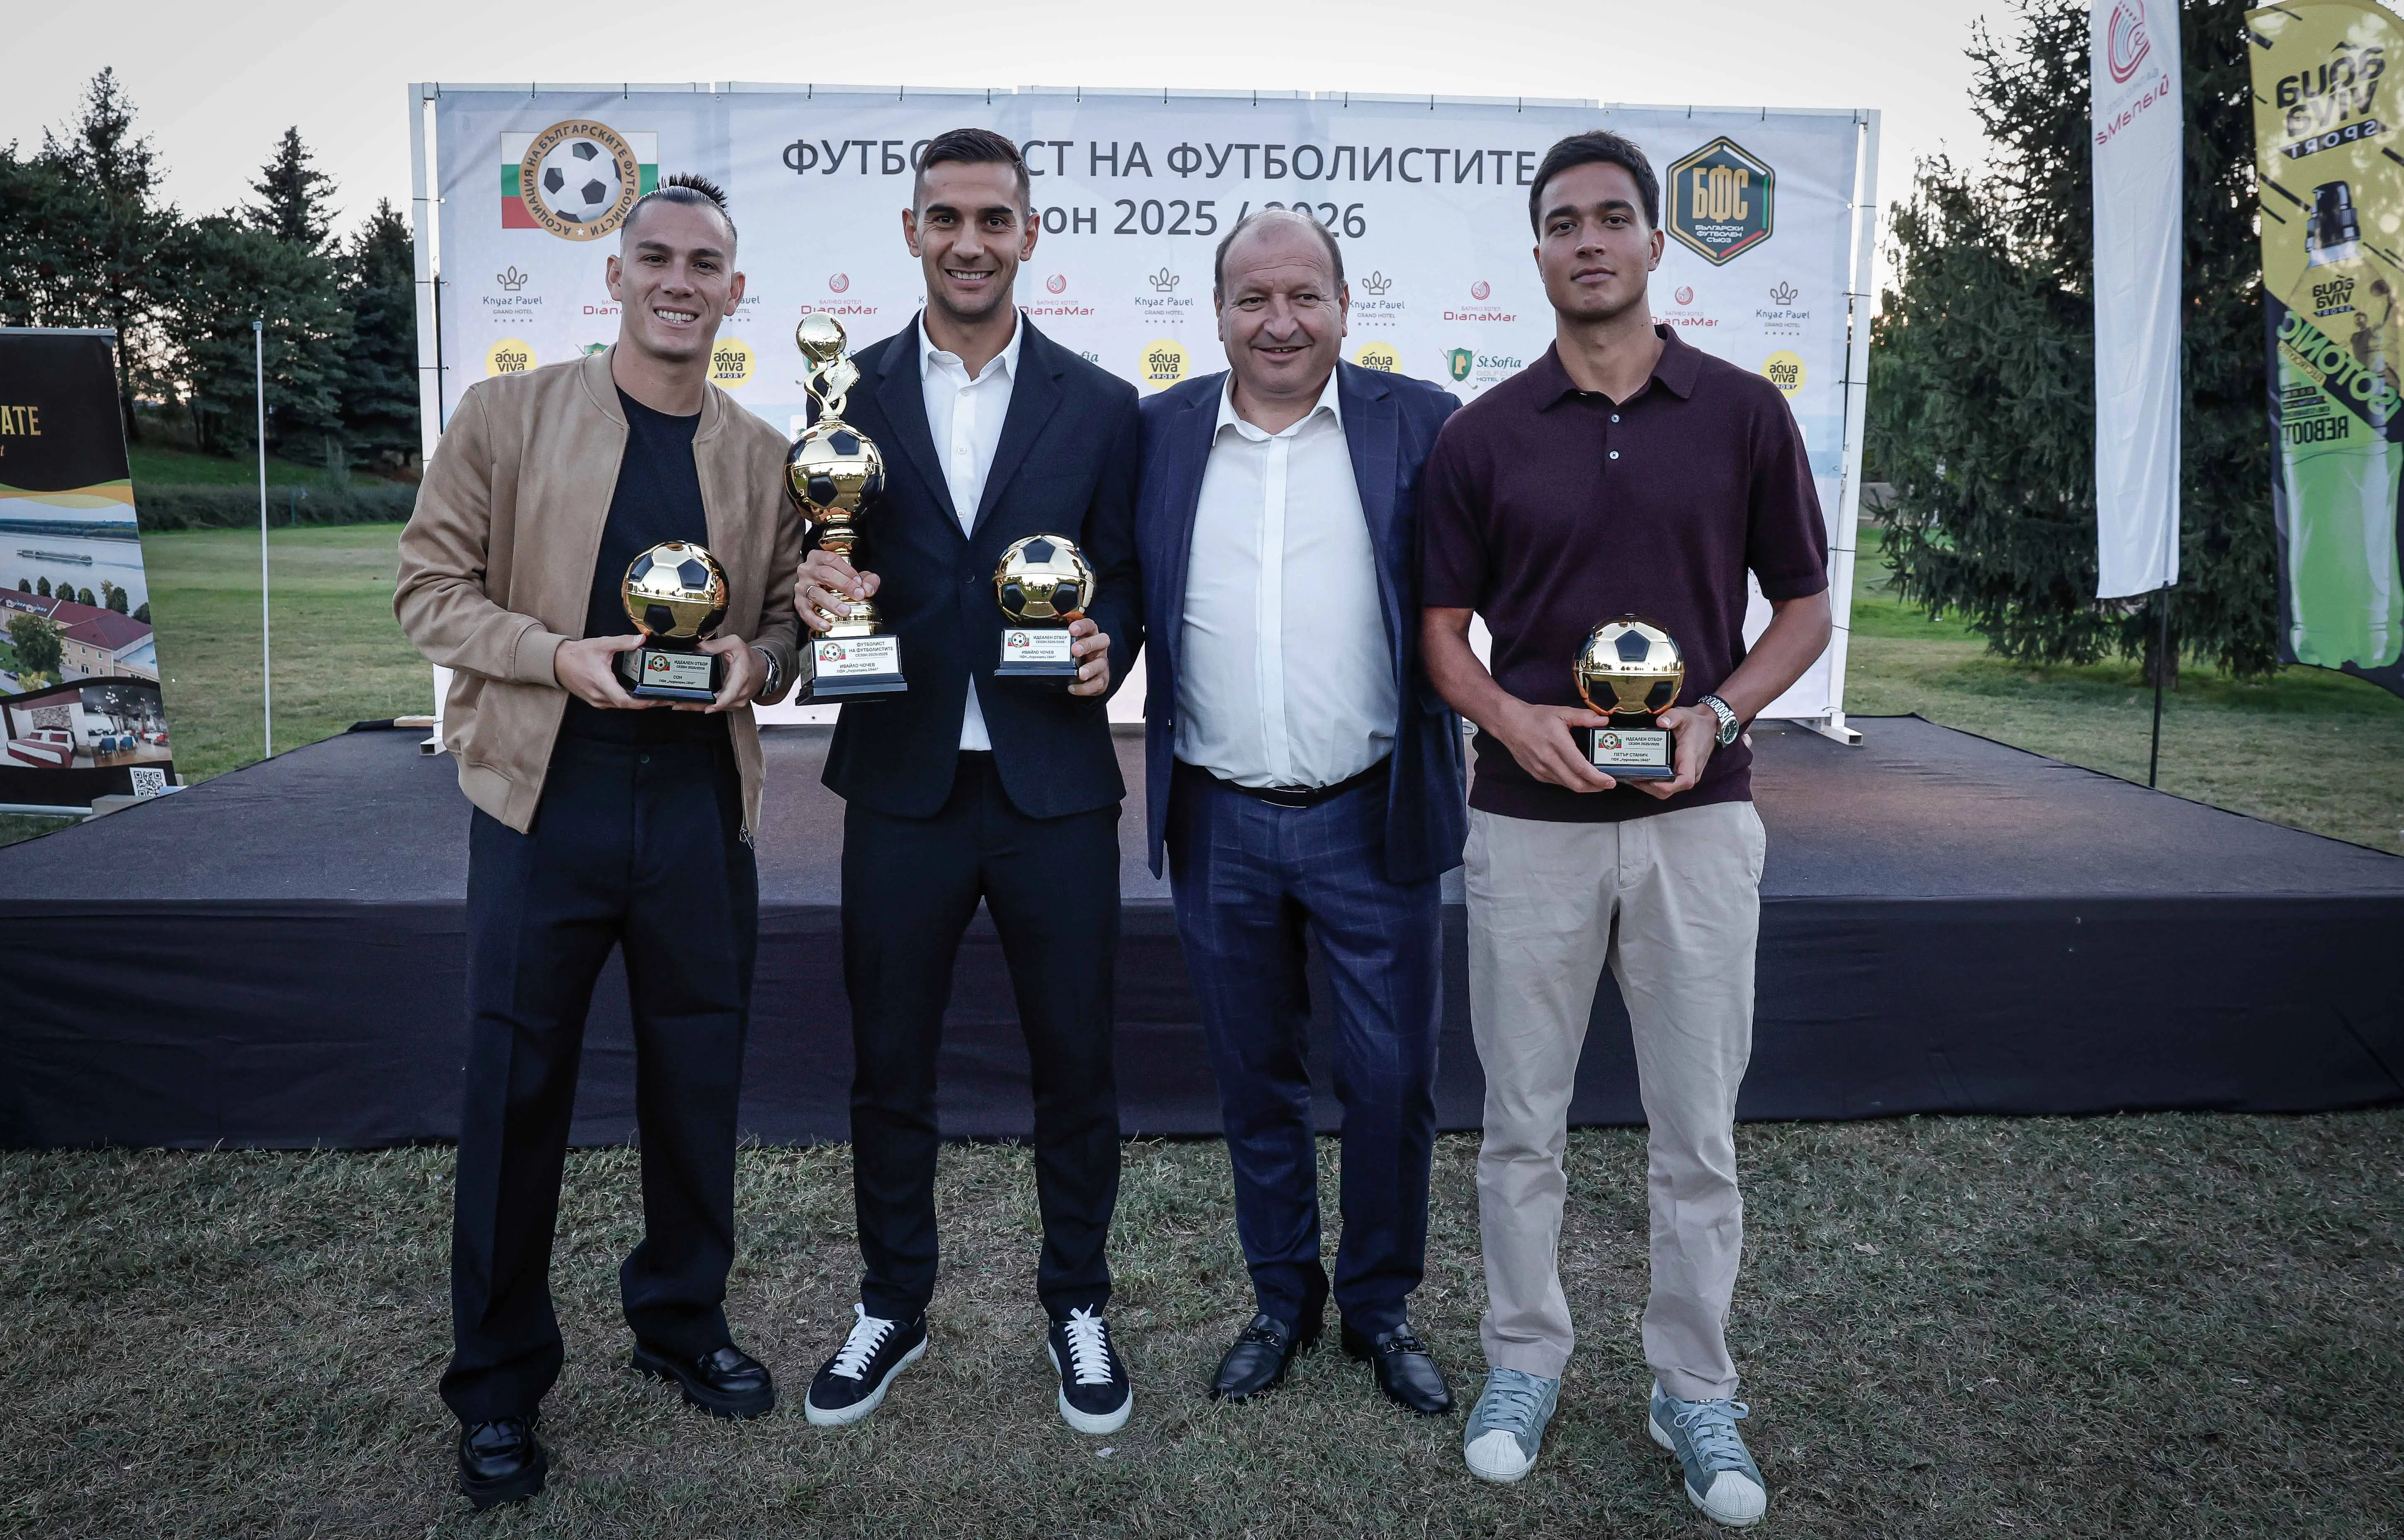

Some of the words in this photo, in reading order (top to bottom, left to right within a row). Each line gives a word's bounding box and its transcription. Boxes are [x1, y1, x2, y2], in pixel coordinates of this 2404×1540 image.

[539, 124, 627, 158] БЪЛГАРСКИТЕ
[527, 151, 540, 167] НА
[782, 139, 1073, 176] ФУТБОСТ
[1090, 141, 1153, 177] НА
[1167, 142, 1535, 185] ФУТБОЛИСТИТЕ
[590, 160, 635, 236] ФУТБОЛИСТИ
[1692, 164, 1749, 223] БФС
[525, 169, 571, 236] АСОЦИАЦИЯ
[1114, 199, 1217, 236] 2025
[483, 296, 512, 306] Knyaz
[1135, 297, 1164, 307] Knyaz
[1444, 312, 1517, 321] DianaMar
[1756, 309, 1783, 319] Knyaz
[497, 362, 525, 372] viva
[716, 361, 743, 371] viva
[1151, 363, 1178, 372] viva
[1771, 374, 1795, 383] viva
